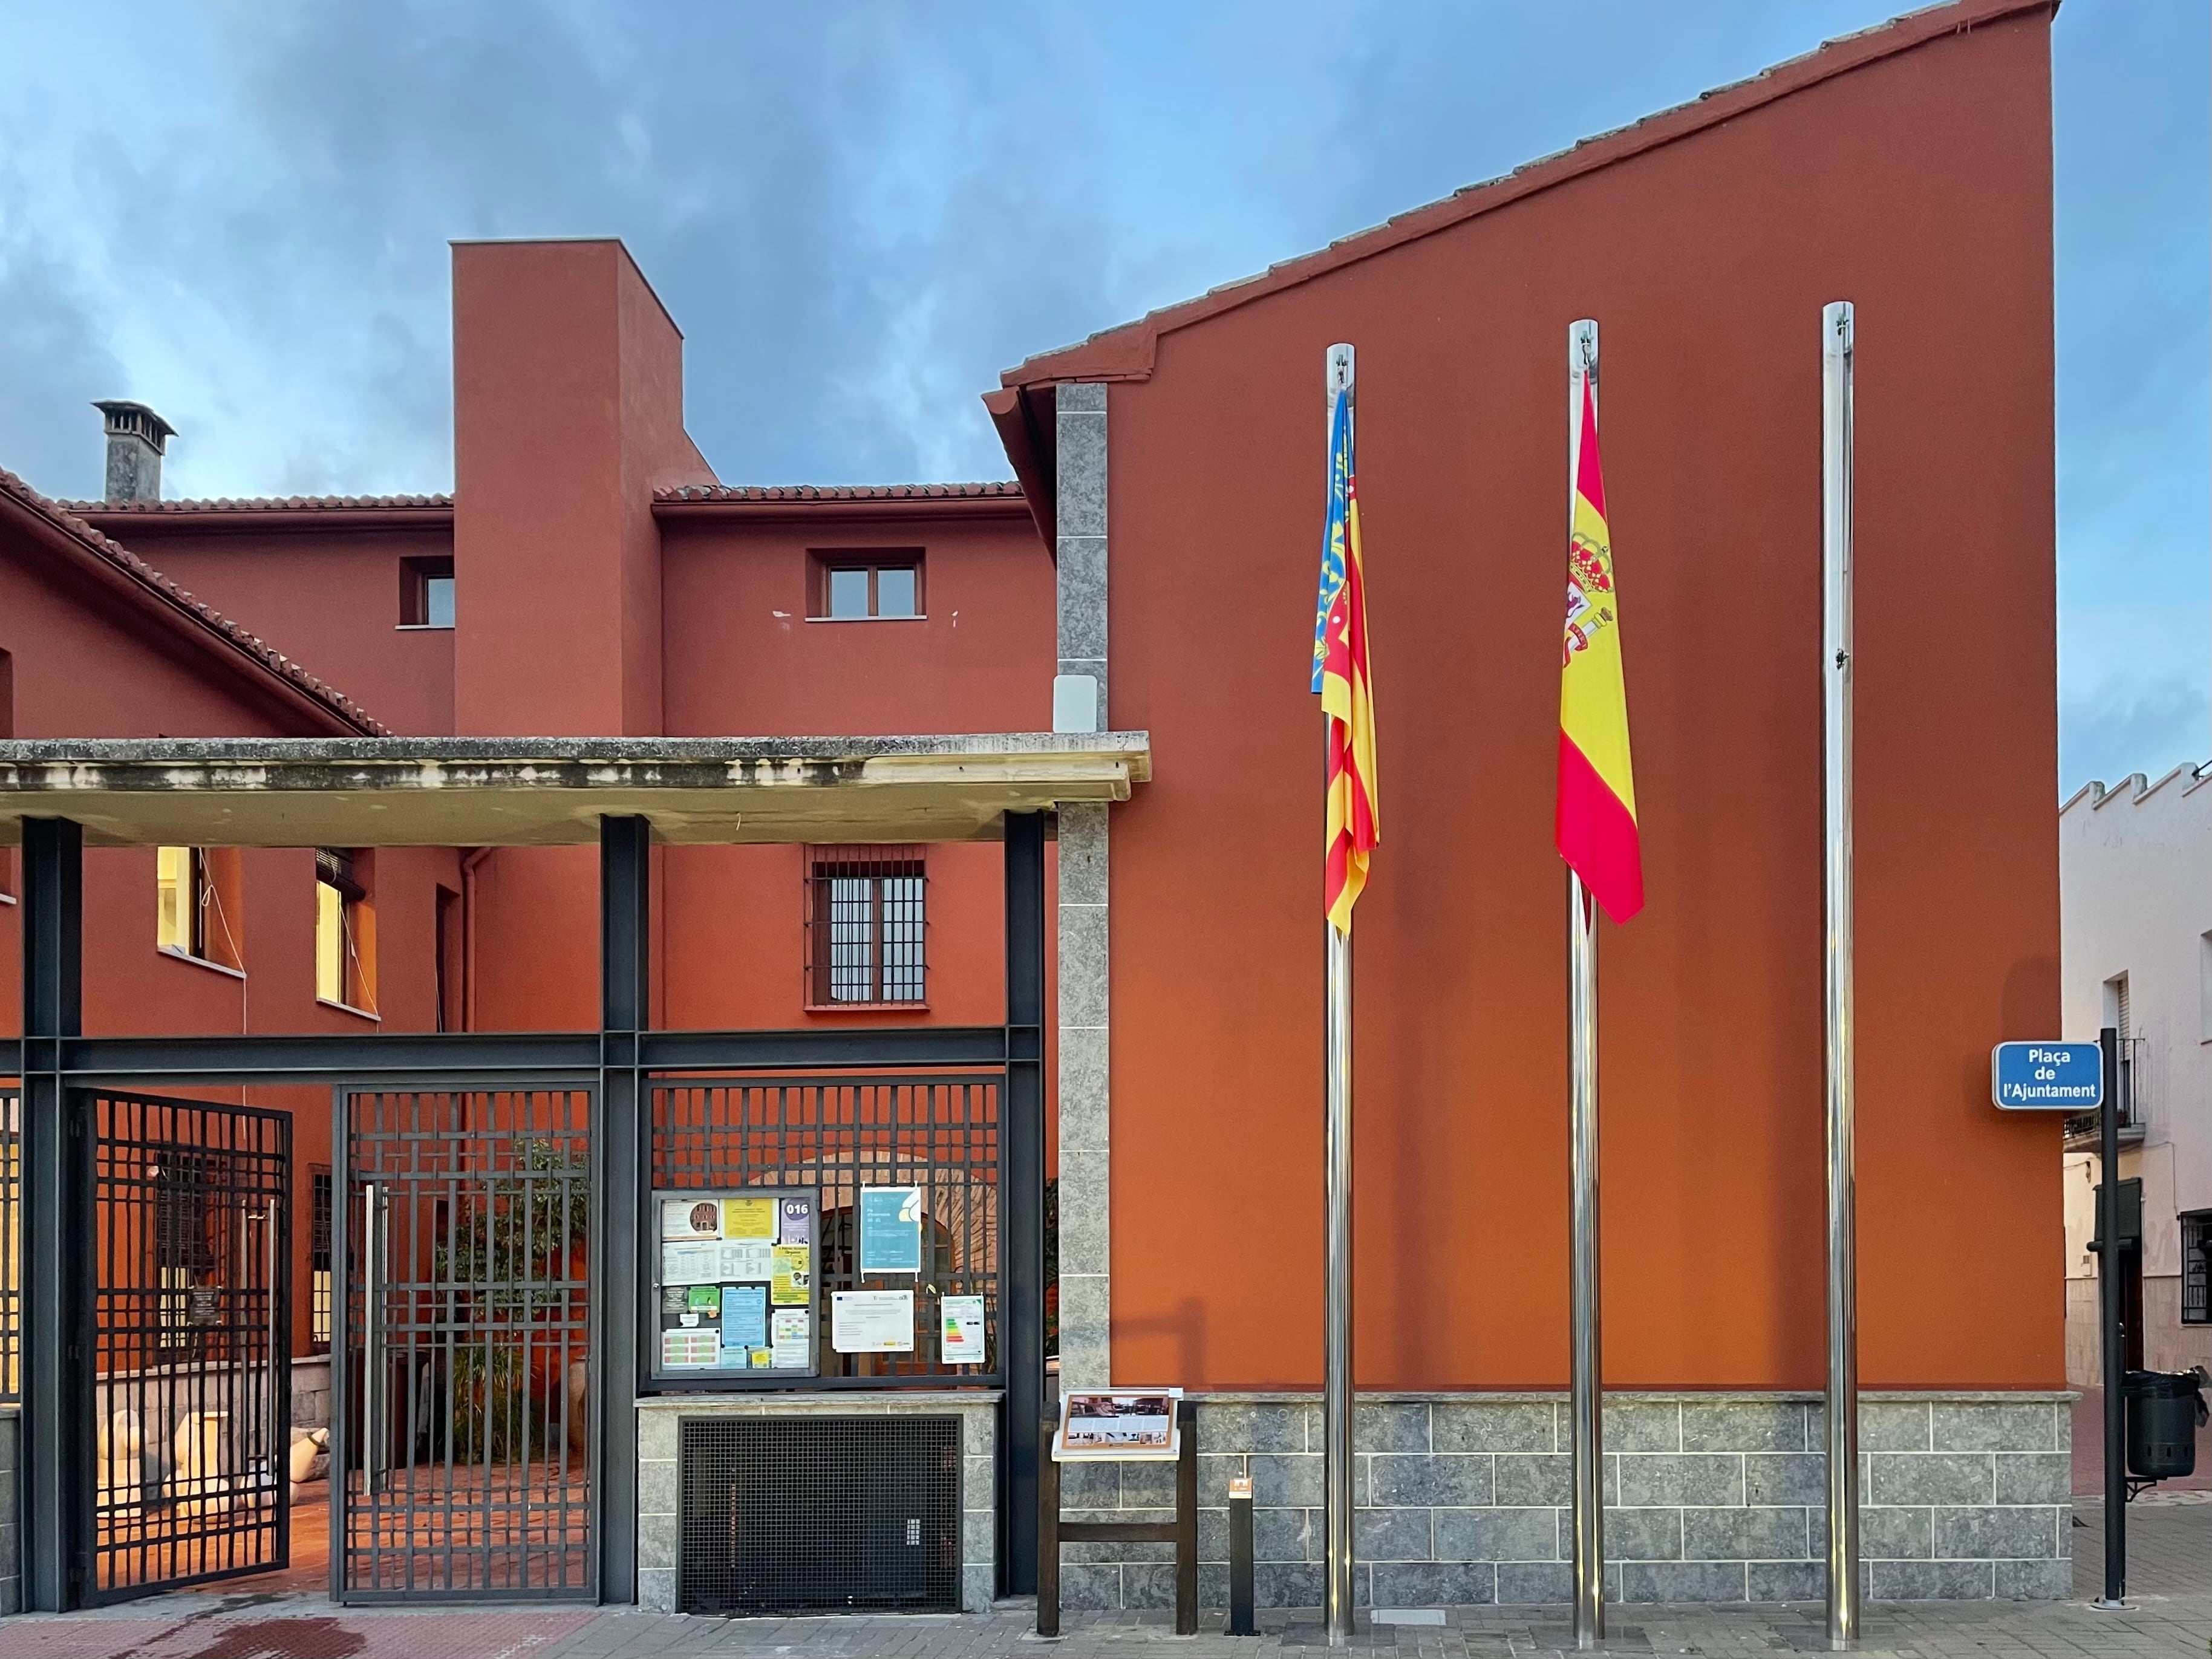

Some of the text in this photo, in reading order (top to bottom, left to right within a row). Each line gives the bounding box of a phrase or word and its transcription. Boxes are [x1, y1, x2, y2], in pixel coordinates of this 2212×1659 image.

[2029, 1048, 2070, 1066] Plaça
[2034, 1066, 2055, 1080] de
[2003, 1083, 2096, 1101] l'Ajuntament
[786, 1204, 809, 1214] 016
